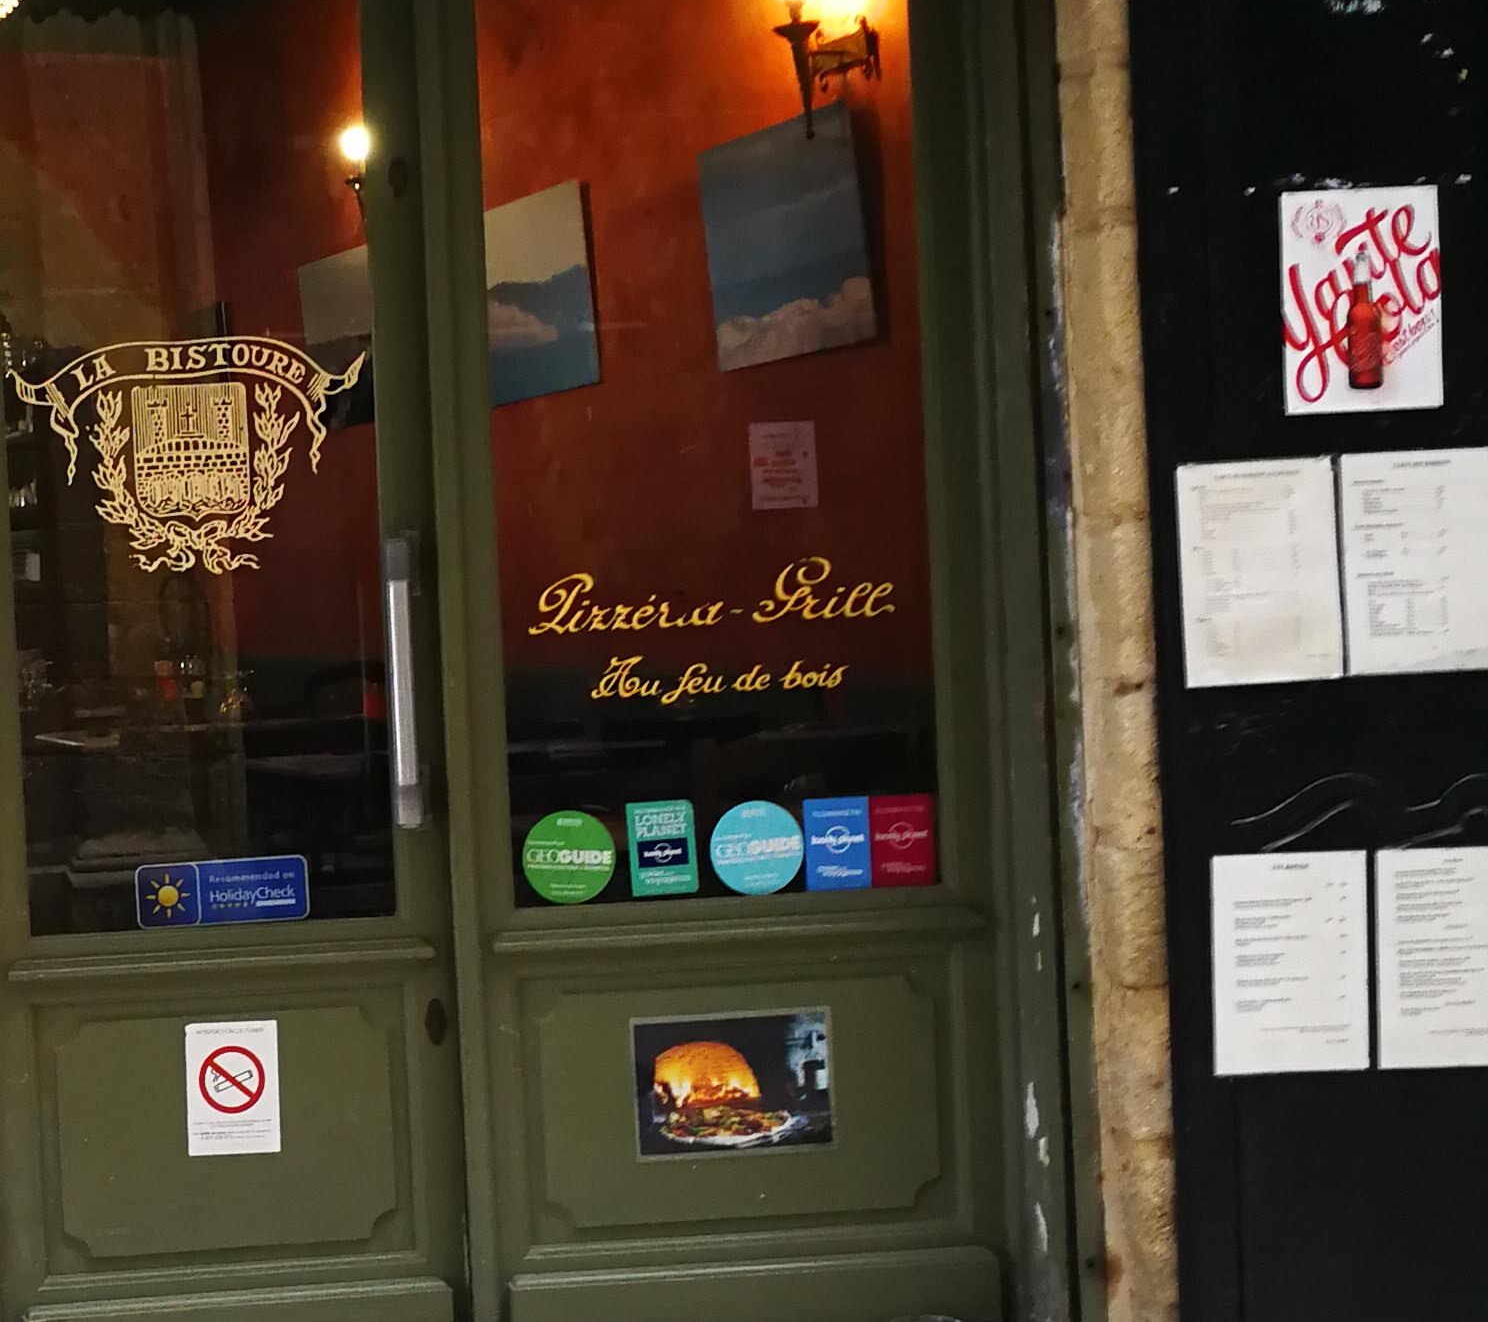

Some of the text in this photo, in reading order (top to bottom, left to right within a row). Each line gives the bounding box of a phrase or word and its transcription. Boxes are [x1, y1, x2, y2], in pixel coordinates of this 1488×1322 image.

[71, 343, 307, 391] LA BISTOURE
[752, 556, 896, 624] Grill
[590, 655, 851, 706] Au feu de bois
[635, 811, 687, 826] LONELY
[208, 870, 280, 884] Recommended
[209, 884, 296, 904] HolidayCheck
